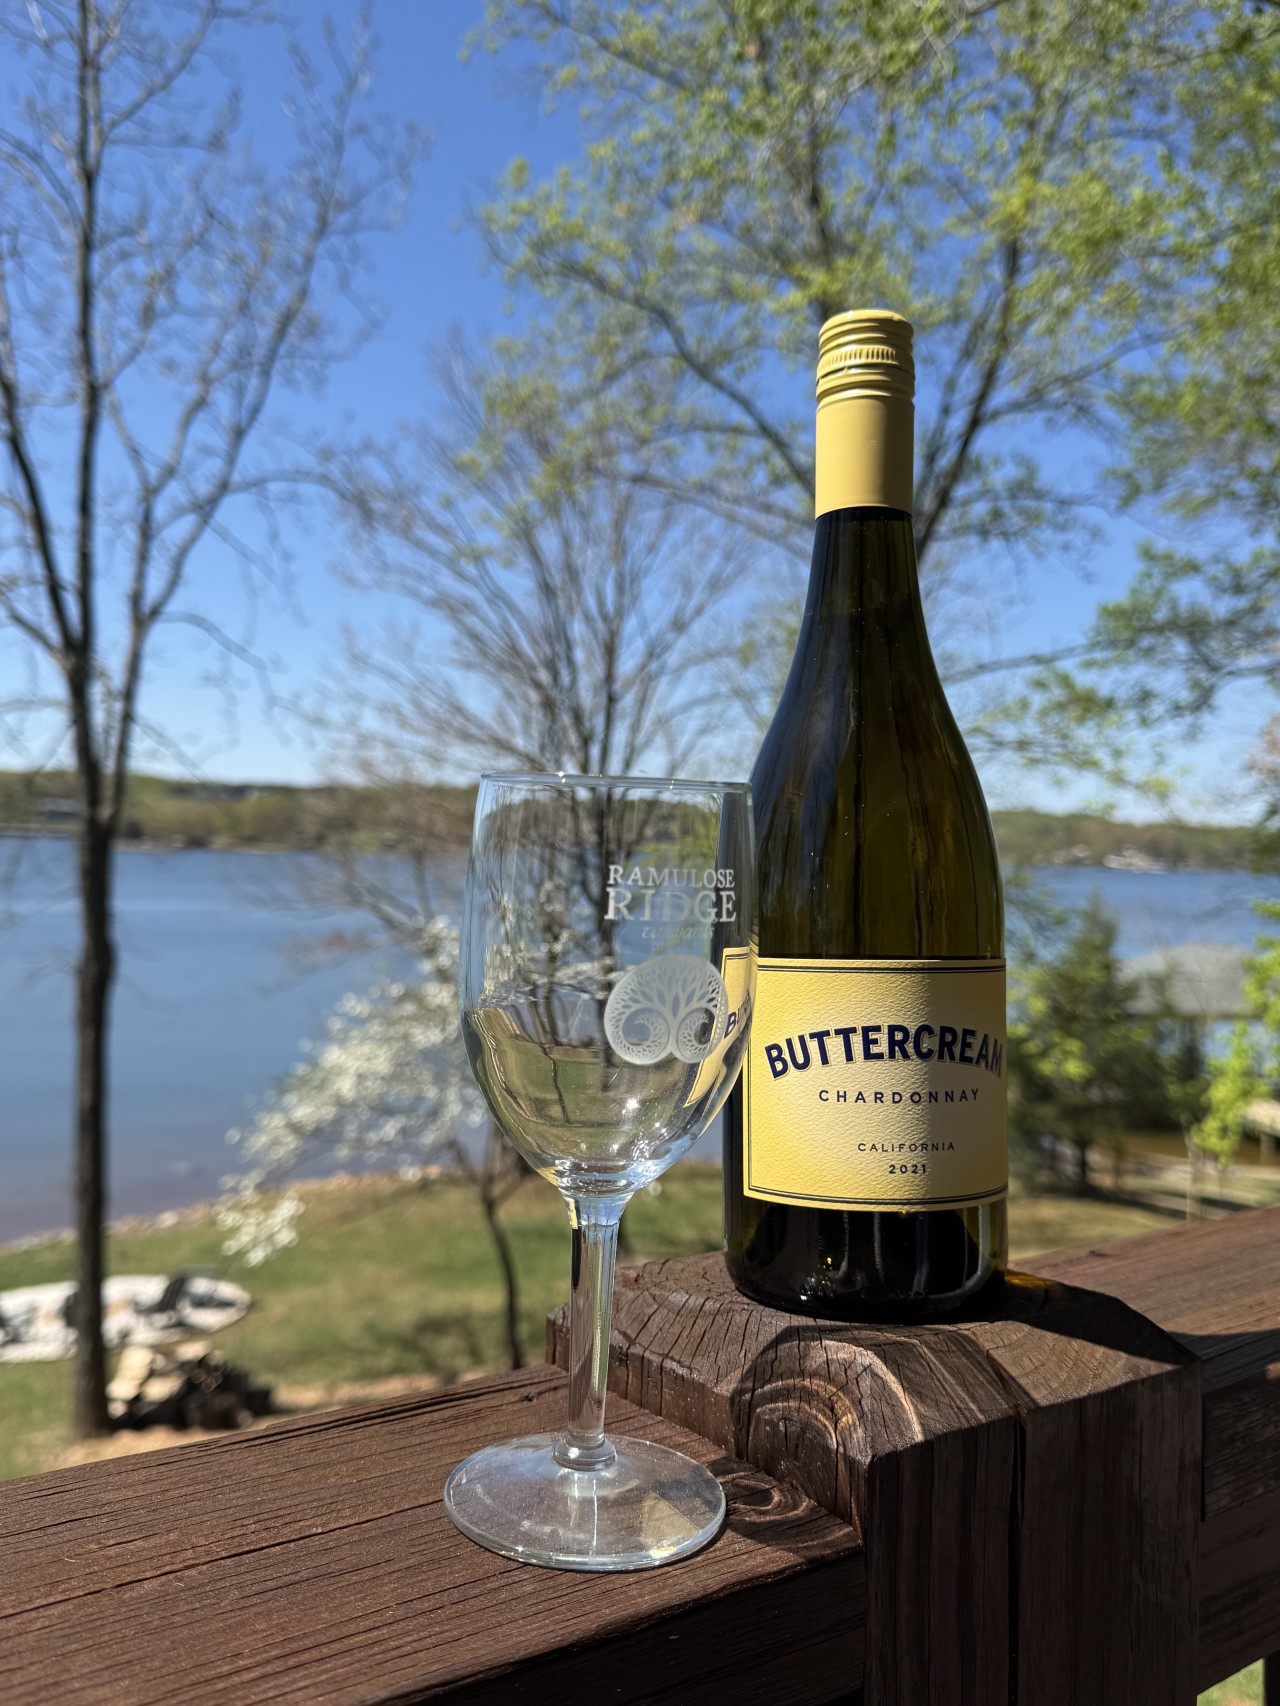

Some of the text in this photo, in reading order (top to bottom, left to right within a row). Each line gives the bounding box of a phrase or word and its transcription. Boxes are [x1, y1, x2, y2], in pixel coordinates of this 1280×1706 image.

[607, 864, 735, 888] RAMULOSE
[604, 887, 736, 923] RIDGE
[764, 1024, 1003, 1078] BUTTERCREAM
[818, 1088, 980, 1104] CHARDONNAY
[857, 1142, 955, 1153] CALIFORNIA
[888, 1164, 927, 1174] 2021
